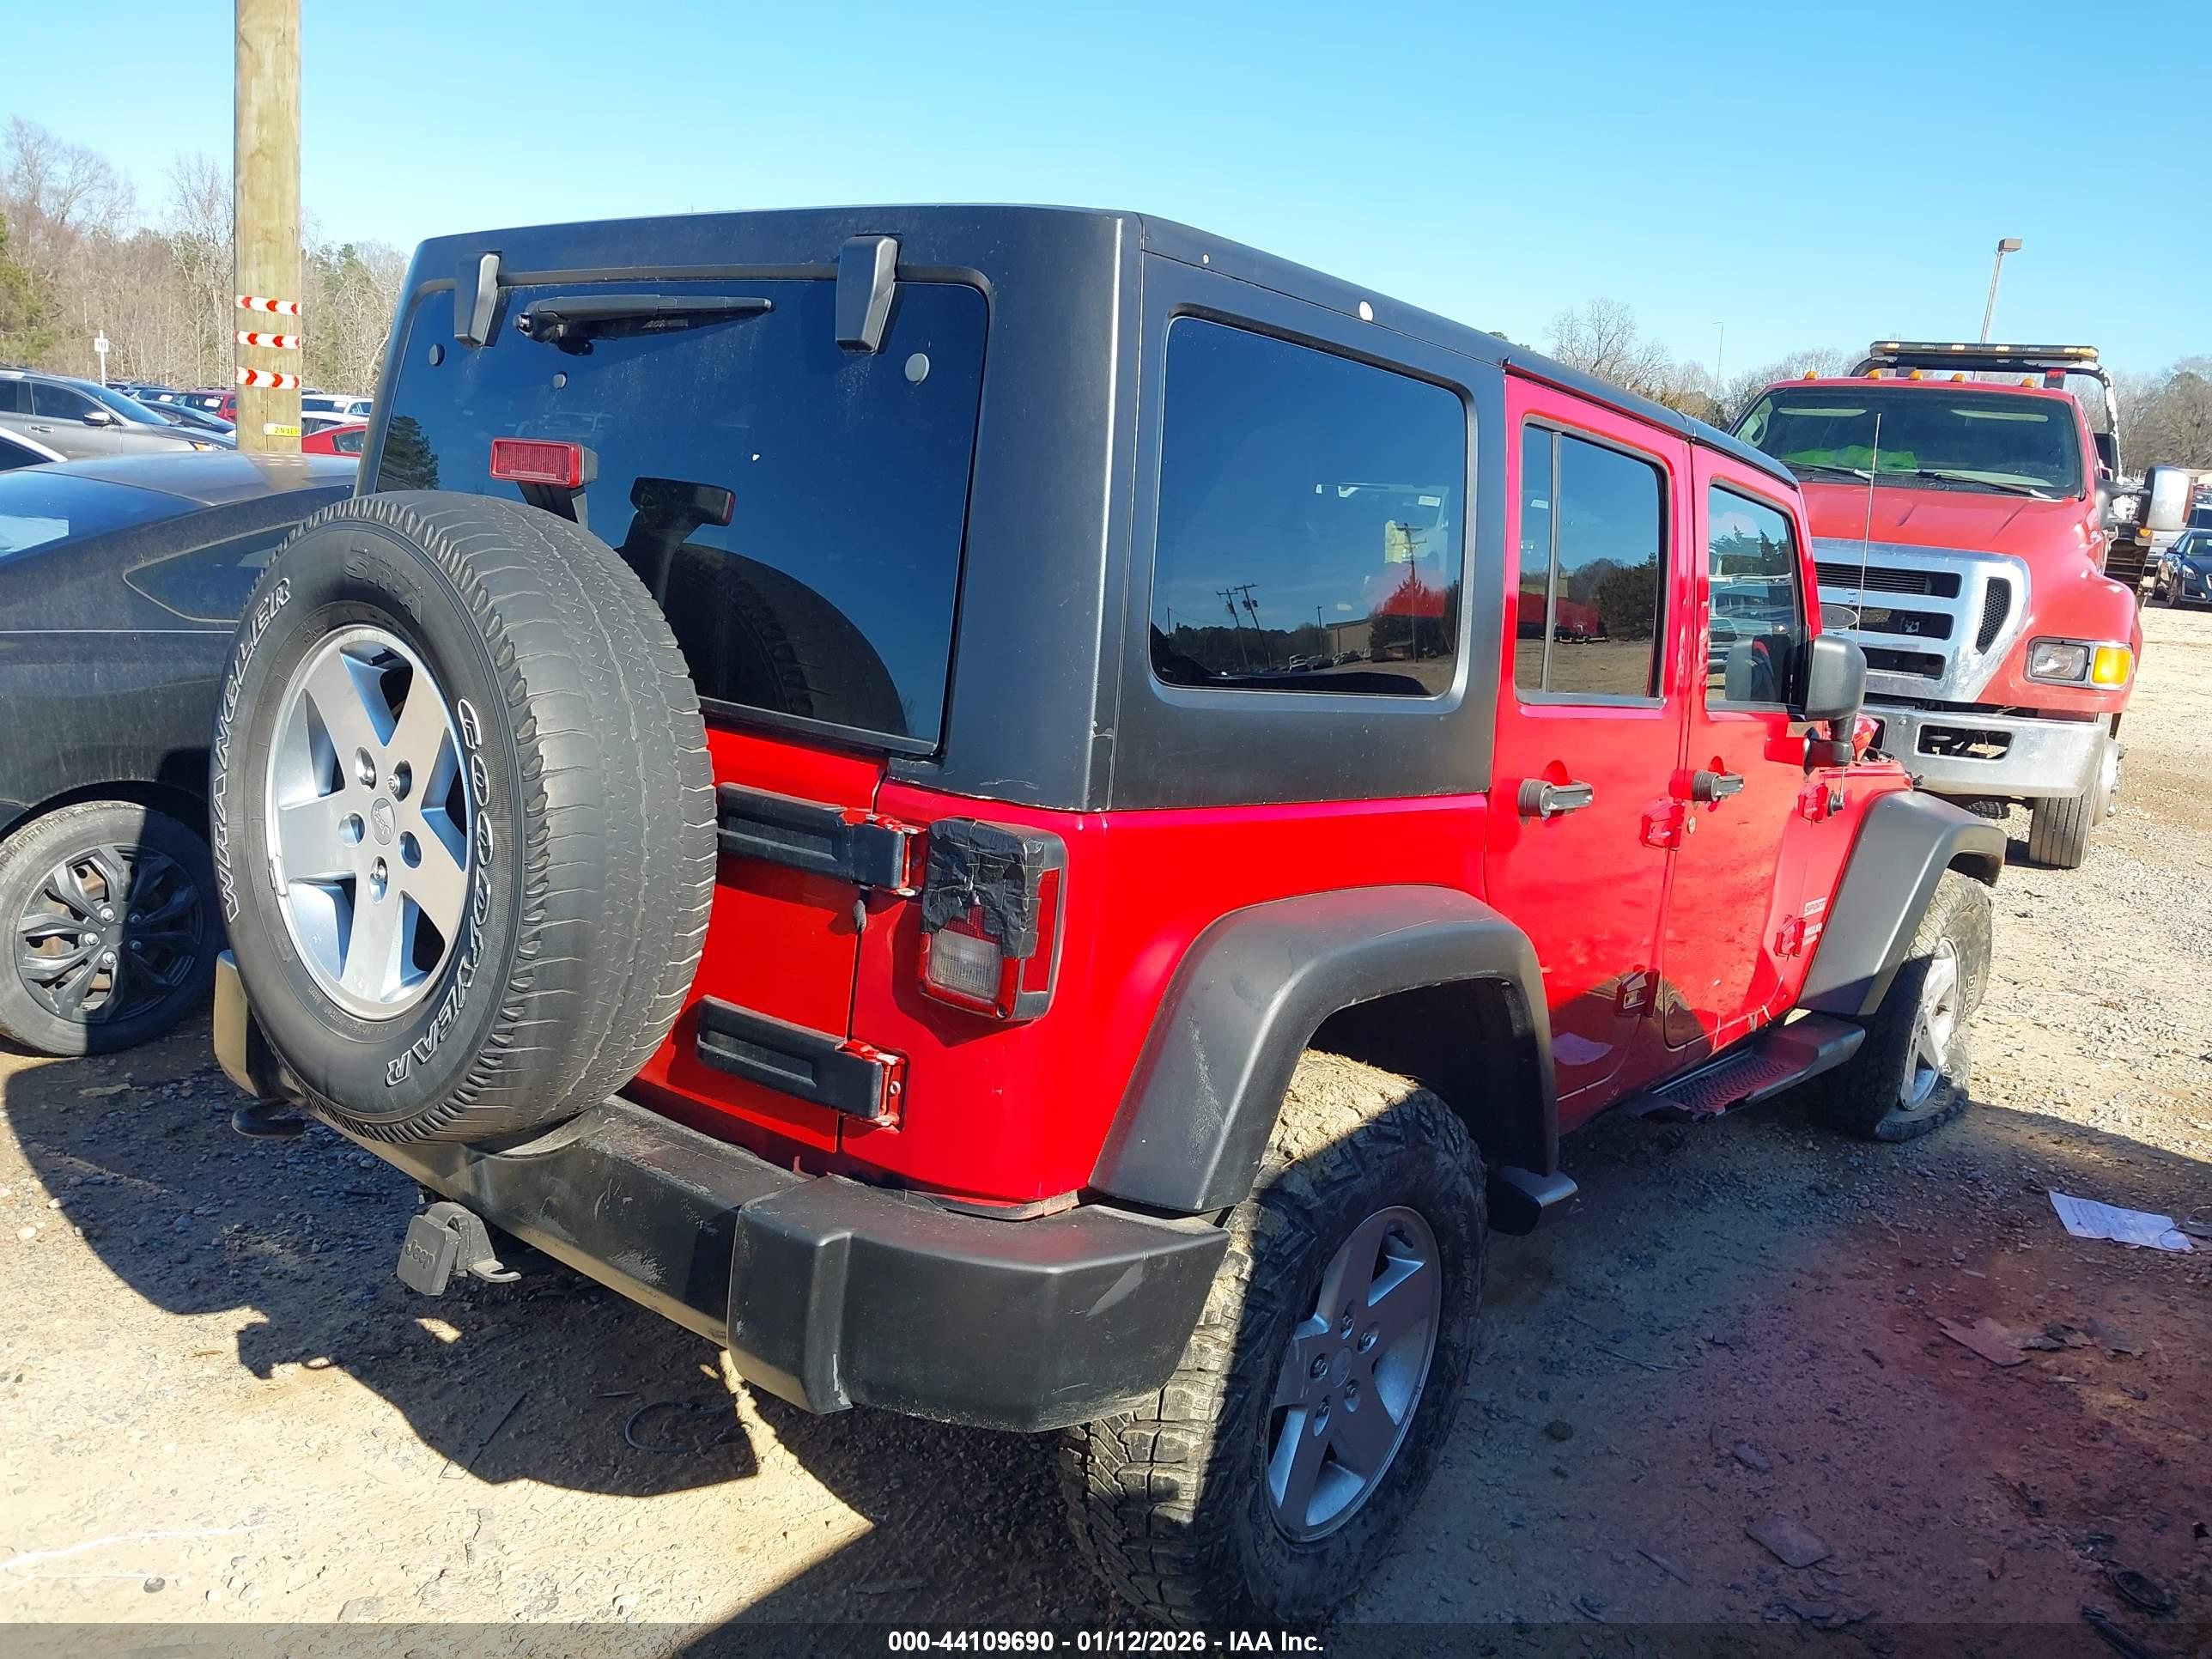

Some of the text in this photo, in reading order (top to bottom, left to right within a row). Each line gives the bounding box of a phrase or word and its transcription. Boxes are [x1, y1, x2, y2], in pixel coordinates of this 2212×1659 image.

[213, 578, 291, 923] WRANGLER
[385, 697, 494, 1085] GOODYEAR
[404, 1240, 435, 1270] Jeep
